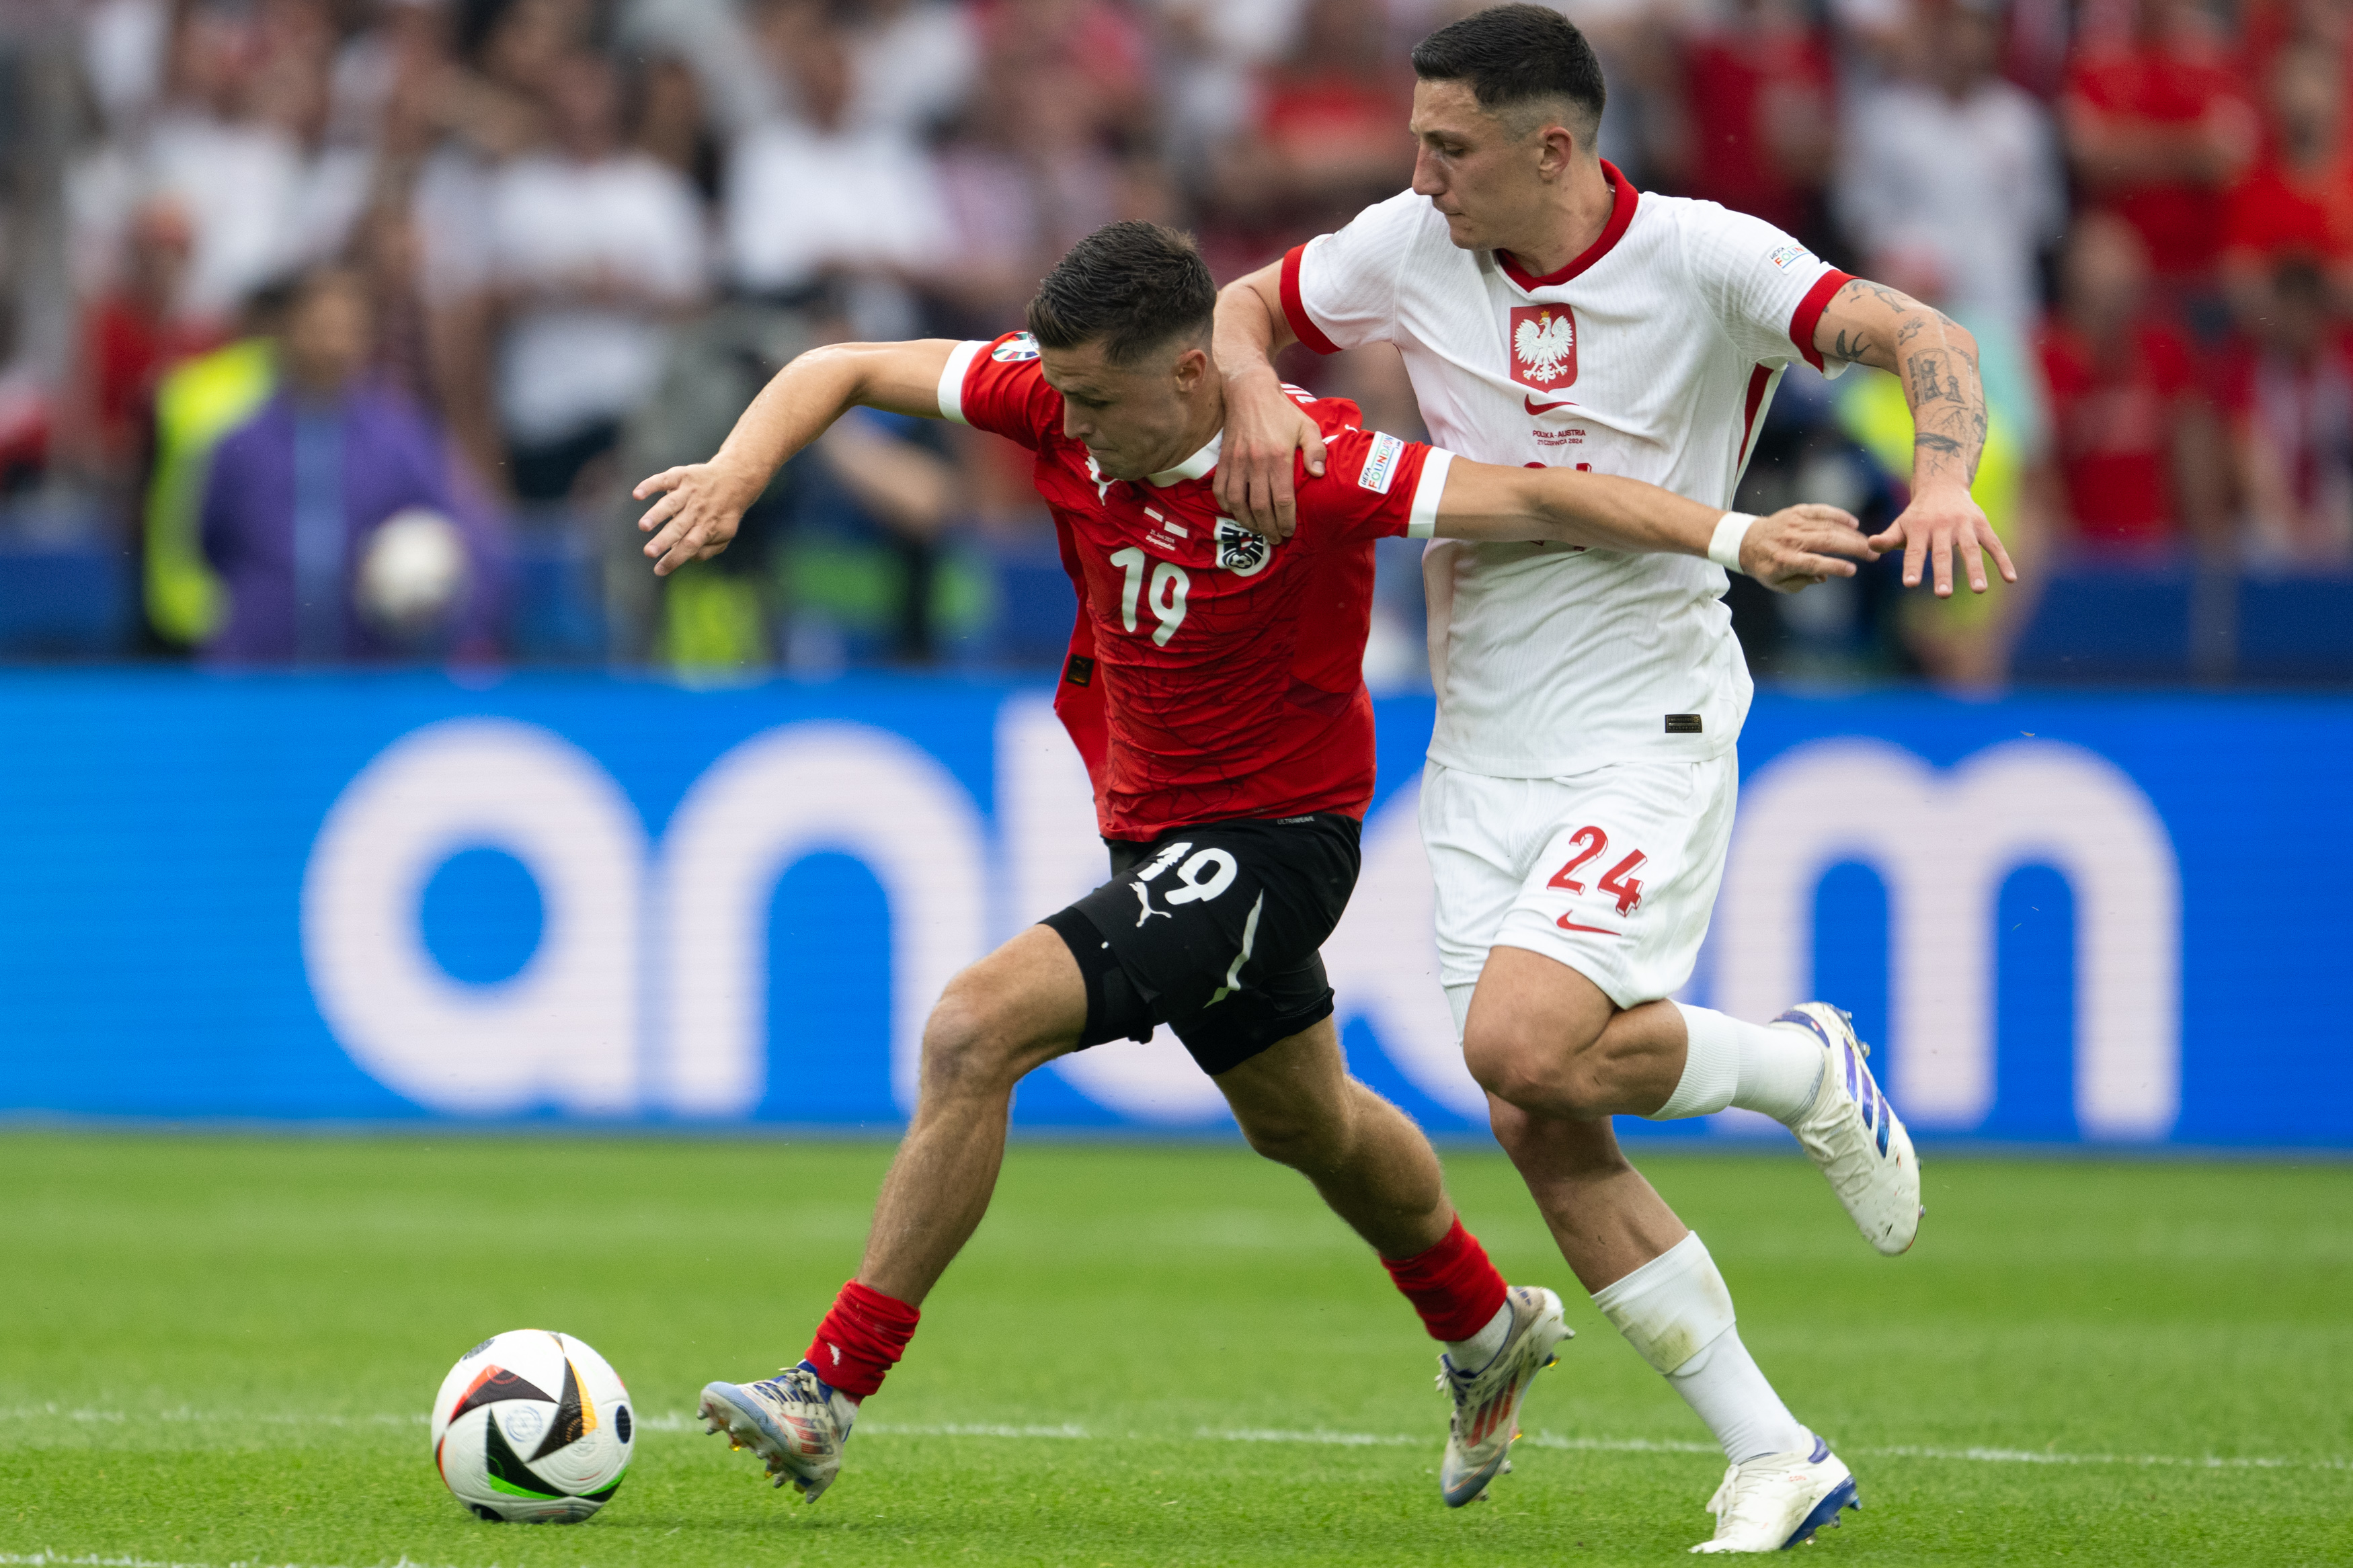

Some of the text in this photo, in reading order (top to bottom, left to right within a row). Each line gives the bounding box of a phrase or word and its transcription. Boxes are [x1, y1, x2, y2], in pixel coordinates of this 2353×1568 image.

[1774, 246, 1808, 266] FOUN
[1558, 429, 1586, 438] AUSTRIA
[1361, 467, 1372, 486] UEFA
[1110, 546, 1190, 647] 19
[1138, 842, 1238, 905] 19
[1546, 825, 1648, 918] 24
